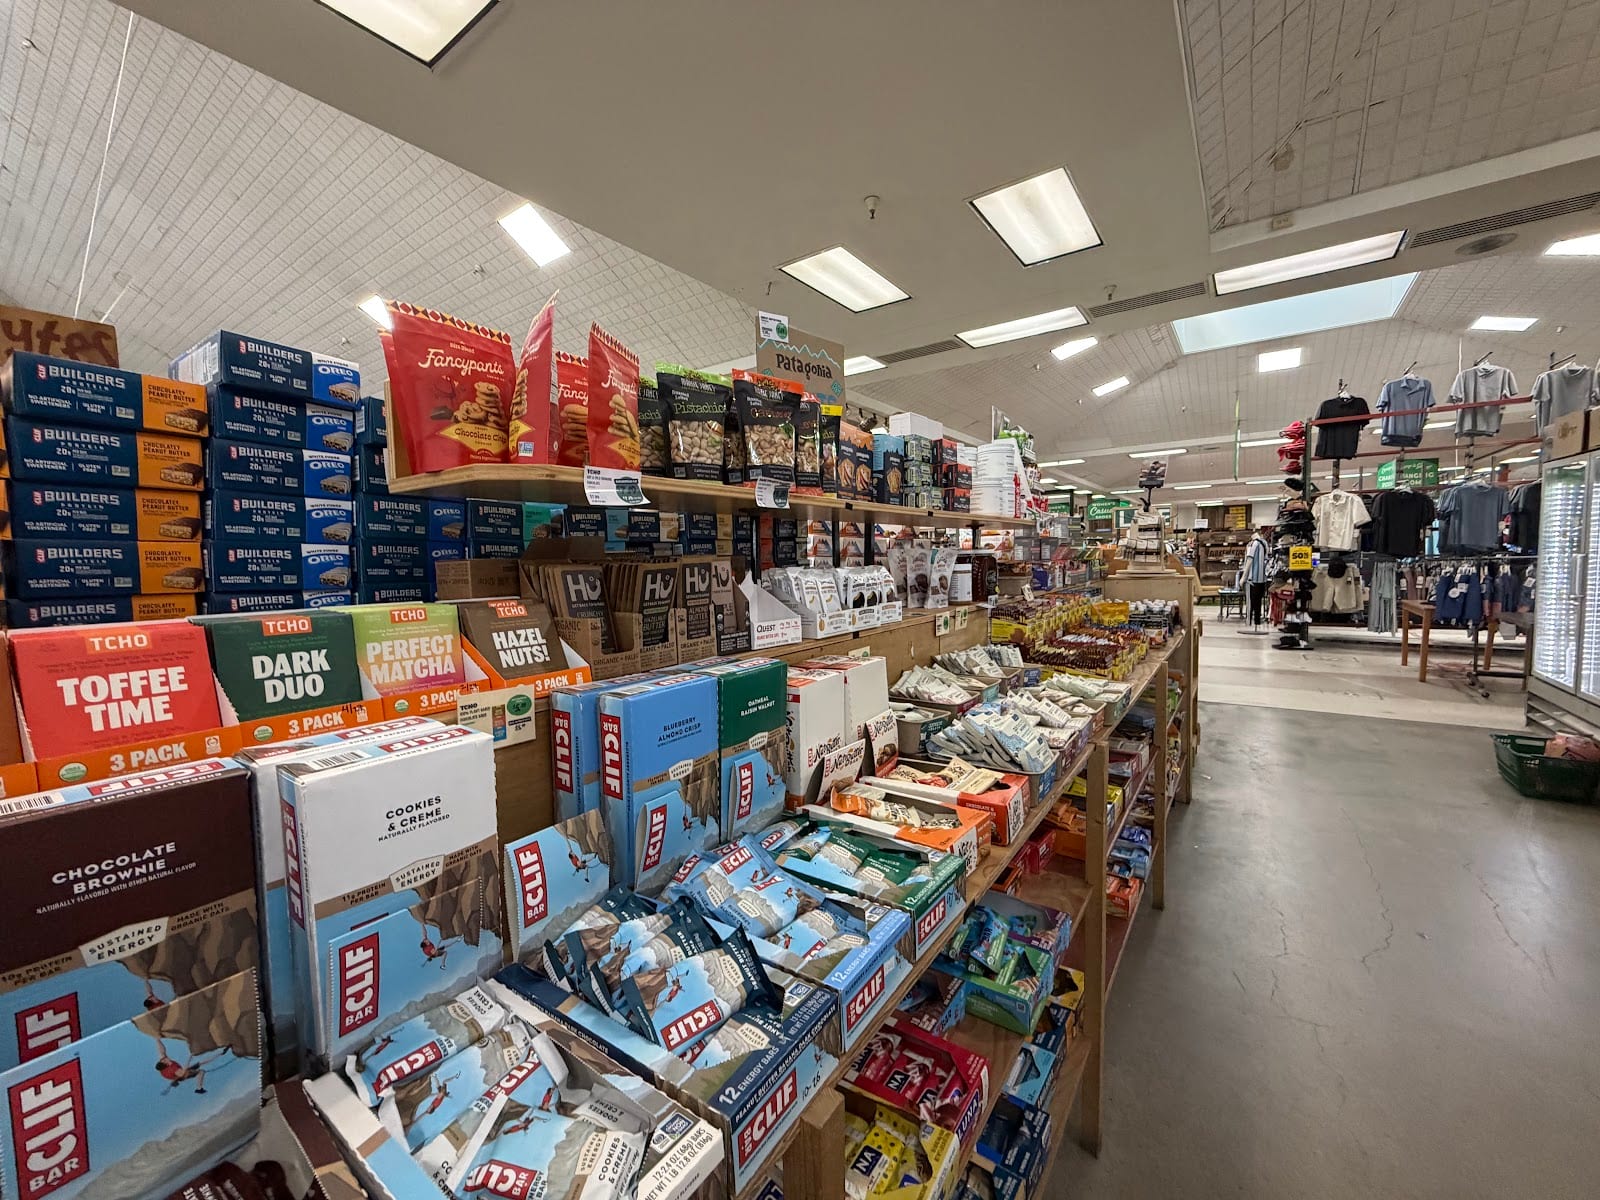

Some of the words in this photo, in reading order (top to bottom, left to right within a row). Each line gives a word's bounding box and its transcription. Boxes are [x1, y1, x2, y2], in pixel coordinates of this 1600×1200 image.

[247, 342, 303, 364] BUILDERS
[418, 348, 505, 376] Fancypants
[318, 366, 353, 377] OREO
[776, 354, 833, 380] Patagonia
[48, 365, 125, 389] BUILDERS
[65, 380, 109, 391] PROTEIN
[148, 384, 186, 396] CHOCOLATEY
[148, 391, 172, 401] PEANUT
[173, 395, 195, 403] BUTTER
[242, 397, 297, 416] BUILDERS
[311, 416, 347, 426] OREO
[44, 428, 121, 447] BUILDERS
[454, 427, 491, 440] Chocolate
[60, 441, 104, 450] PROTEIN
[143, 441, 181, 450] CHOCOLATEY
[143, 447, 168, 456] PEANUT
[168, 449, 190, 457] BUTTER
[238, 447, 294, 462] BUILDERS
[309, 460, 345, 470] OREO
[44, 491, 120, 505] BUILDERS
[241, 499, 296, 512] BUILDERS
[379, 501, 422, 513] BUILDERS
[311, 509, 347, 519] OREO
[433, 508, 461, 516] OREO
[484, 506, 516, 516] BUILDERS
[47, 548, 123, 559] BUILDERS
[236, 550, 292, 560] BUILDERS
[377, 546, 419, 556] BUILDERS
[432, 549, 459, 557] OREO
[485, 544, 519, 553] BUILDERS
[307, 554, 344, 564] OREO
[239, 595, 294, 608] BUILDERS
[310, 596, 344, 607] OREO
[381, 588, 422, 598] BUILDERS
[40, 604, 117, 618] BUILDERS
[392, 609, 426, 622] TCHO
[498, 605, 525, 617] TCHO
[265, 619, 309, 634] TCHO
[757, 624, 775, 633] QUEST
[89, 634, 148, 651] TCHO
[492, 628, 546, 650] HAZEL
[366, 634, 454, 664] PERFECT
[498, 647, 551, 669] NUTS!
[252, 649, 331, 680] DARK
[370, 657, 456, 685] MATCHA
[56, 666, 188, 706] TOFFEE
[264, 673, 325, 703] DUO
[535, 680, 542, 692] 3
[543, 675, 569, 690] PACK
[420, 694, 429, 707] 3
[432, 690, 461, 706] PACK
[460, 702, 478, 711] TCHO
[740, 707, 758, 716] RAISIN
[758, 700, 775, 710] WALNUT
[748, 696, 769, 707] OATMEAL
[84, 695, 173, 732] TIME
[288, 719, 300, 734] 3
[302, 711, 344, 732] PACK
[554, 717, 568, 729] BAR
[603, 721, 619, 734] BAR
[658, 730, 683, 742] ALMOND
[684, 722, 701, 733] CRISP
[663, 717, 696, 732] BLUEBERRY
[110, 753, 126, 771] 3
[130, 742, 188, 765] PACK
[555, 728, 571, 788] CLIF
[604, 734, 620, 794] CLIF
[740, 768, 752, 807] CLIF
[386, 795, 442, 820] COOKIES
[378, 824, 417, 843] NATURALLY
[418, 814, 451, 829] FLAVORED
[387, 822, 396, 832] &
[400, 807, 442, 828] CREME
[650, 811, 666, 858] CLIF
[51, 842, 177, 884] CHOCOLATE
[645, 853, 659, 866] BAR
[73, 859, 167, 895] BROWNIE
[395, 861, 441, 883] SUSTAINED
[401, 869, 437, 888] ENERGY
[519, 848, 545, 907] CLIF
[36, 897, 76, 914] NATURALLY
[76, 888, 109, 903] FLAVORED
[110, 883, 128, 894] WITH
[128, 878, 147, 889] OTHER
[148, 870, 174, 882] NATURAL
[175, 862, 197, 874] FLAVOR
[357, 882, 386, 898] PROTEIN
[176, 908, 201, 923] MADE
[203, 902, 224, 914] WITH
[527, 904, 545, 919] BAR
[924, 901, 945, 933] CLIF
[170, 917, 208, 932] ORGANIC
[88, 925, 162, 955] SUSTAINED
[97, 935, 155, 961] ENERGY
[26, 956, 72, 974] PROTEIN
[345, 946, 374, 1012] CLIF
[831, 972, 846, 983] 12
[855, 969, 883, 1014] CLIF
[345, 1005, 374, 1027] BAR
[702, 1005, 717, 1023] BAR
[668, 1009, 711, 1046] CLIF
[577, 1028, 609, 1054] CHOCOLATE
[719, 1087, 741, 1105] 12
[738, 1062, 763, 1092] ENERGY
[761, 1045, 780, 1064] BARS
[735, 1098, 758, 1122] PEANUT
[752, 1076, 794, 1141] CLIF
[19, 1079, 77, 1172] CLIF
[957, 1099, 978, 1139] LUNA
[598, 1137, 622, 1181] COOKIES
[613, 1144, 628, 1175] CREME
[652, 1162, 670, 1182] 12-2.4
[671, 1155, 679, 1166] OZ
[678, 1142, 693, 1160] (68g)
[692, 1127, 706, 1143] BARS
[29, 1157, 80, 1193] BAR
[657, 1179, 668, 1193] WT
[670, 1165, 680, 1178] LB
[678, 1154, 690, 1171] 12.8
[689, 1147, 698, 1158] OZ
[512, 1172, 529, 1195] BAR
